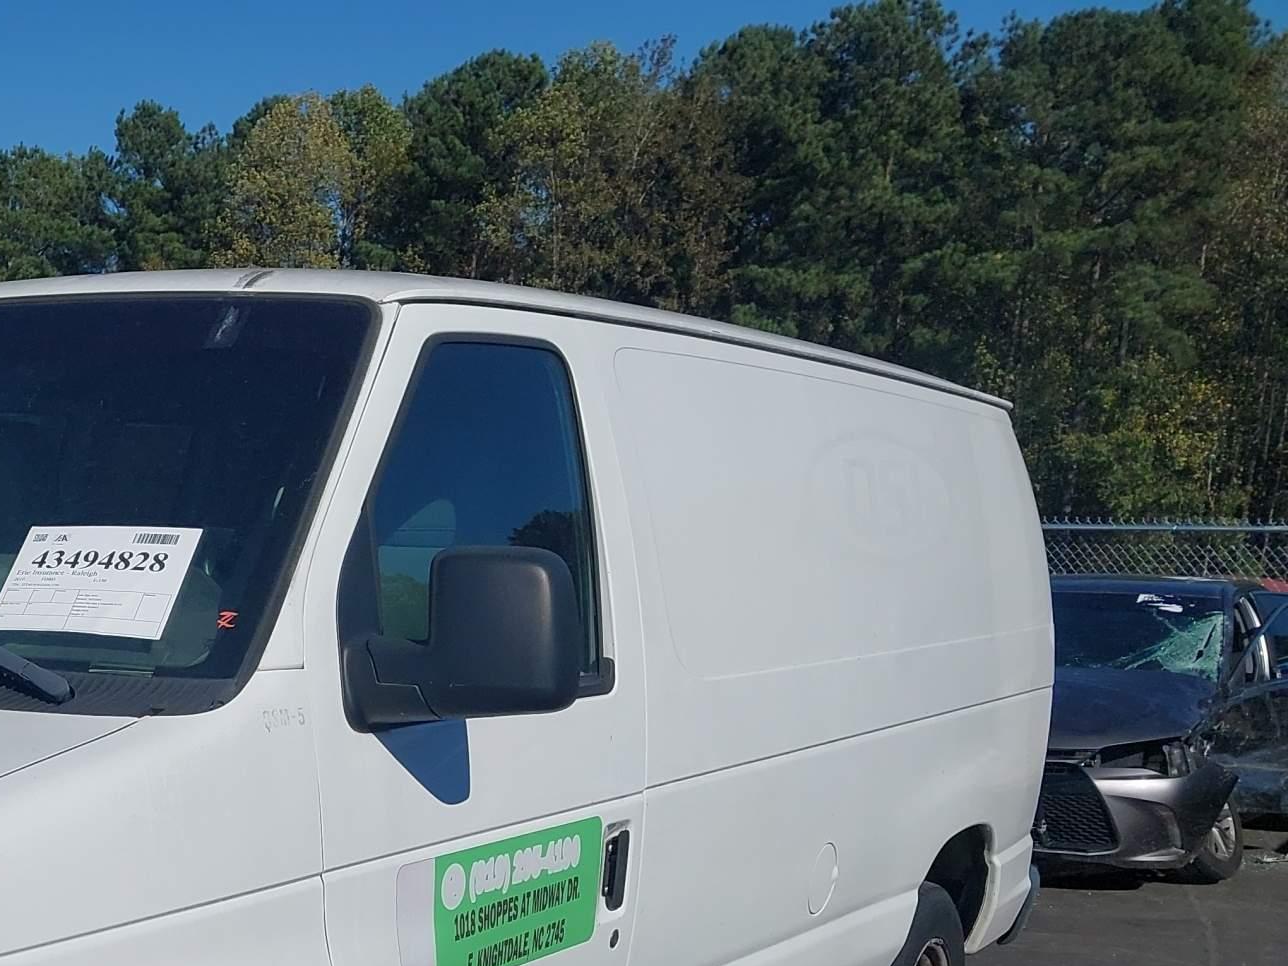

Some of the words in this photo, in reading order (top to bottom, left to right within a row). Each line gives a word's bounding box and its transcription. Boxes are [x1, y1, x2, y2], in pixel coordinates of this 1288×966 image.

[31, 549, 169, 573] 43494828
[454, 908, 476, 942] 1018
[478, 895, 519, 933] SHOPPES
[520, 891, 532, 919] AT
[532, 879, 567, 915] MIDWAY
[566, 876, 581, 903] DR.
[532, 926, 545, 953] NC
[545, 918, 566, 948] 2745
